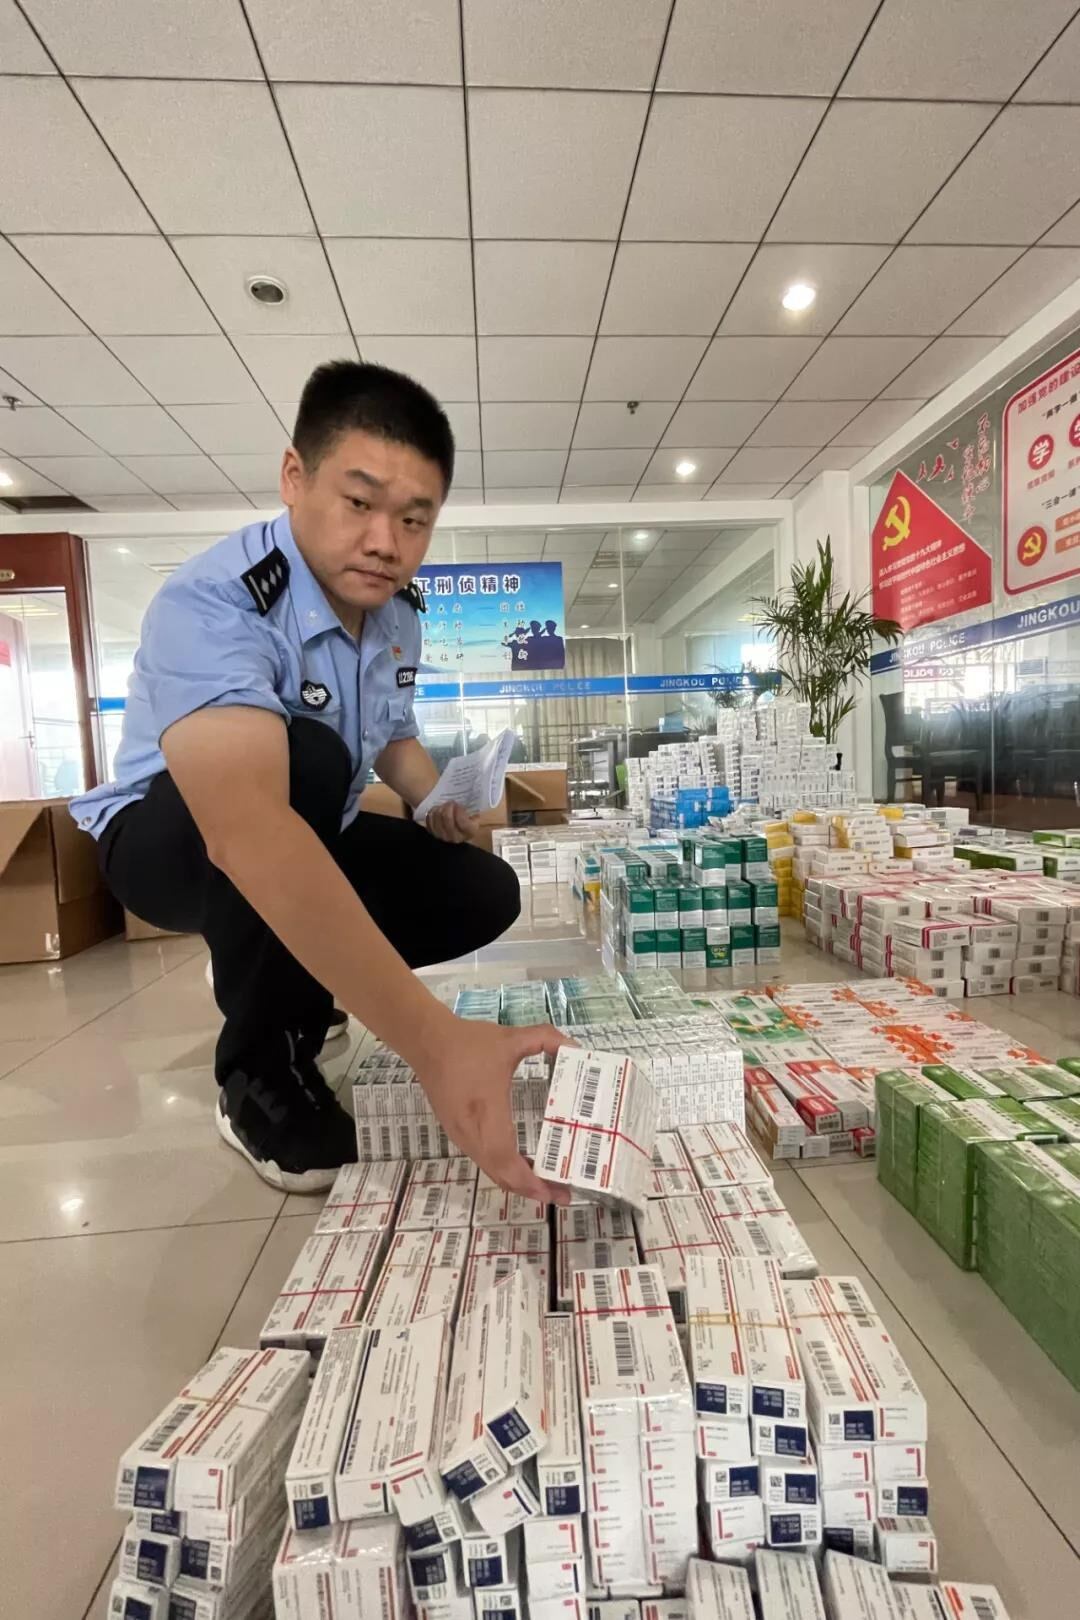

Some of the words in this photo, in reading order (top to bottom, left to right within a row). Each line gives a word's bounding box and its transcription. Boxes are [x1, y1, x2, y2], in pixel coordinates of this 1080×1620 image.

[1031, 439, 1050, 465] 学
[1017, 600, 1080, 628] JINGKOU
[660, 679, 705, 688] JINGKOU
